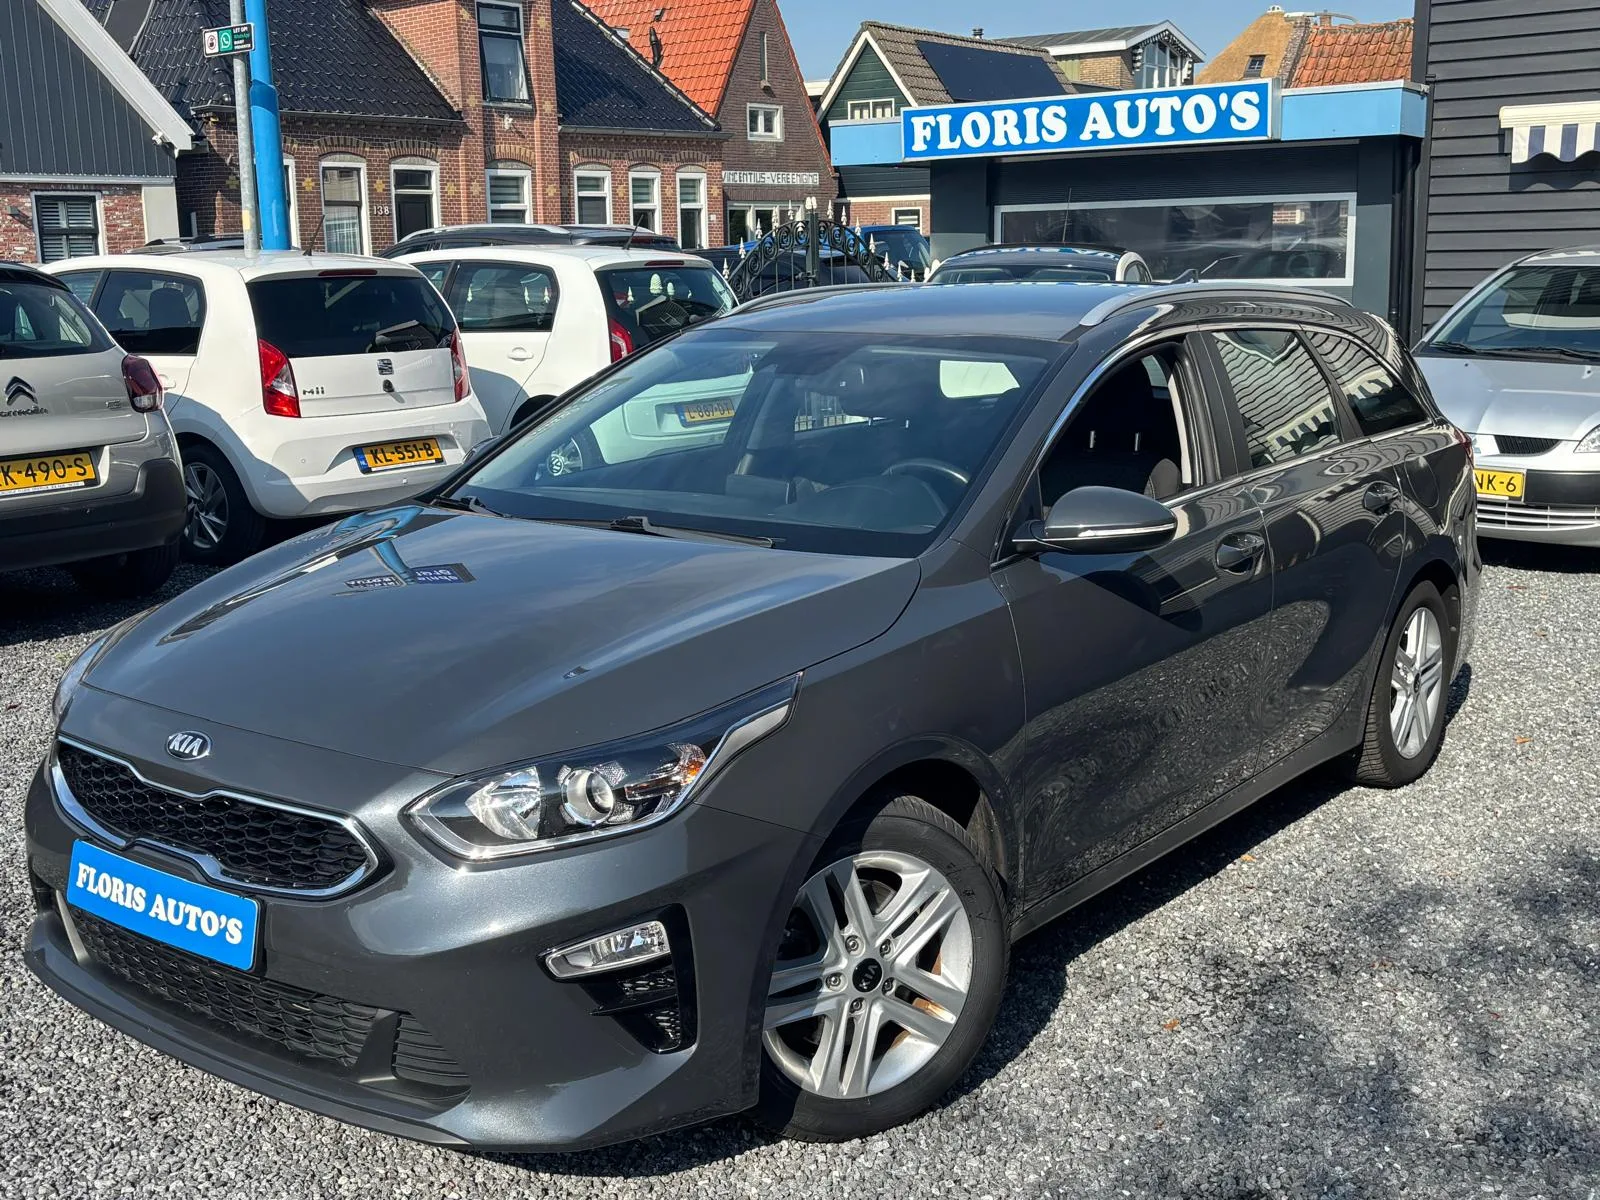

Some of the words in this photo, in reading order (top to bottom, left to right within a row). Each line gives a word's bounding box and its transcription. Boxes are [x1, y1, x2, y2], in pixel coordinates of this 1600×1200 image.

[911, 105, 1067, 152] FLORIS
[1079, 91, 1260, 141] AUTO'S
[373, 205, 390, 215] 138
[370, 442, 435, 464] KL-551-B
[0, 457, 87, 487] K-490-S
[169, 732, 203, 756] KIA
[75, 862, 146, 913] FLORIS
